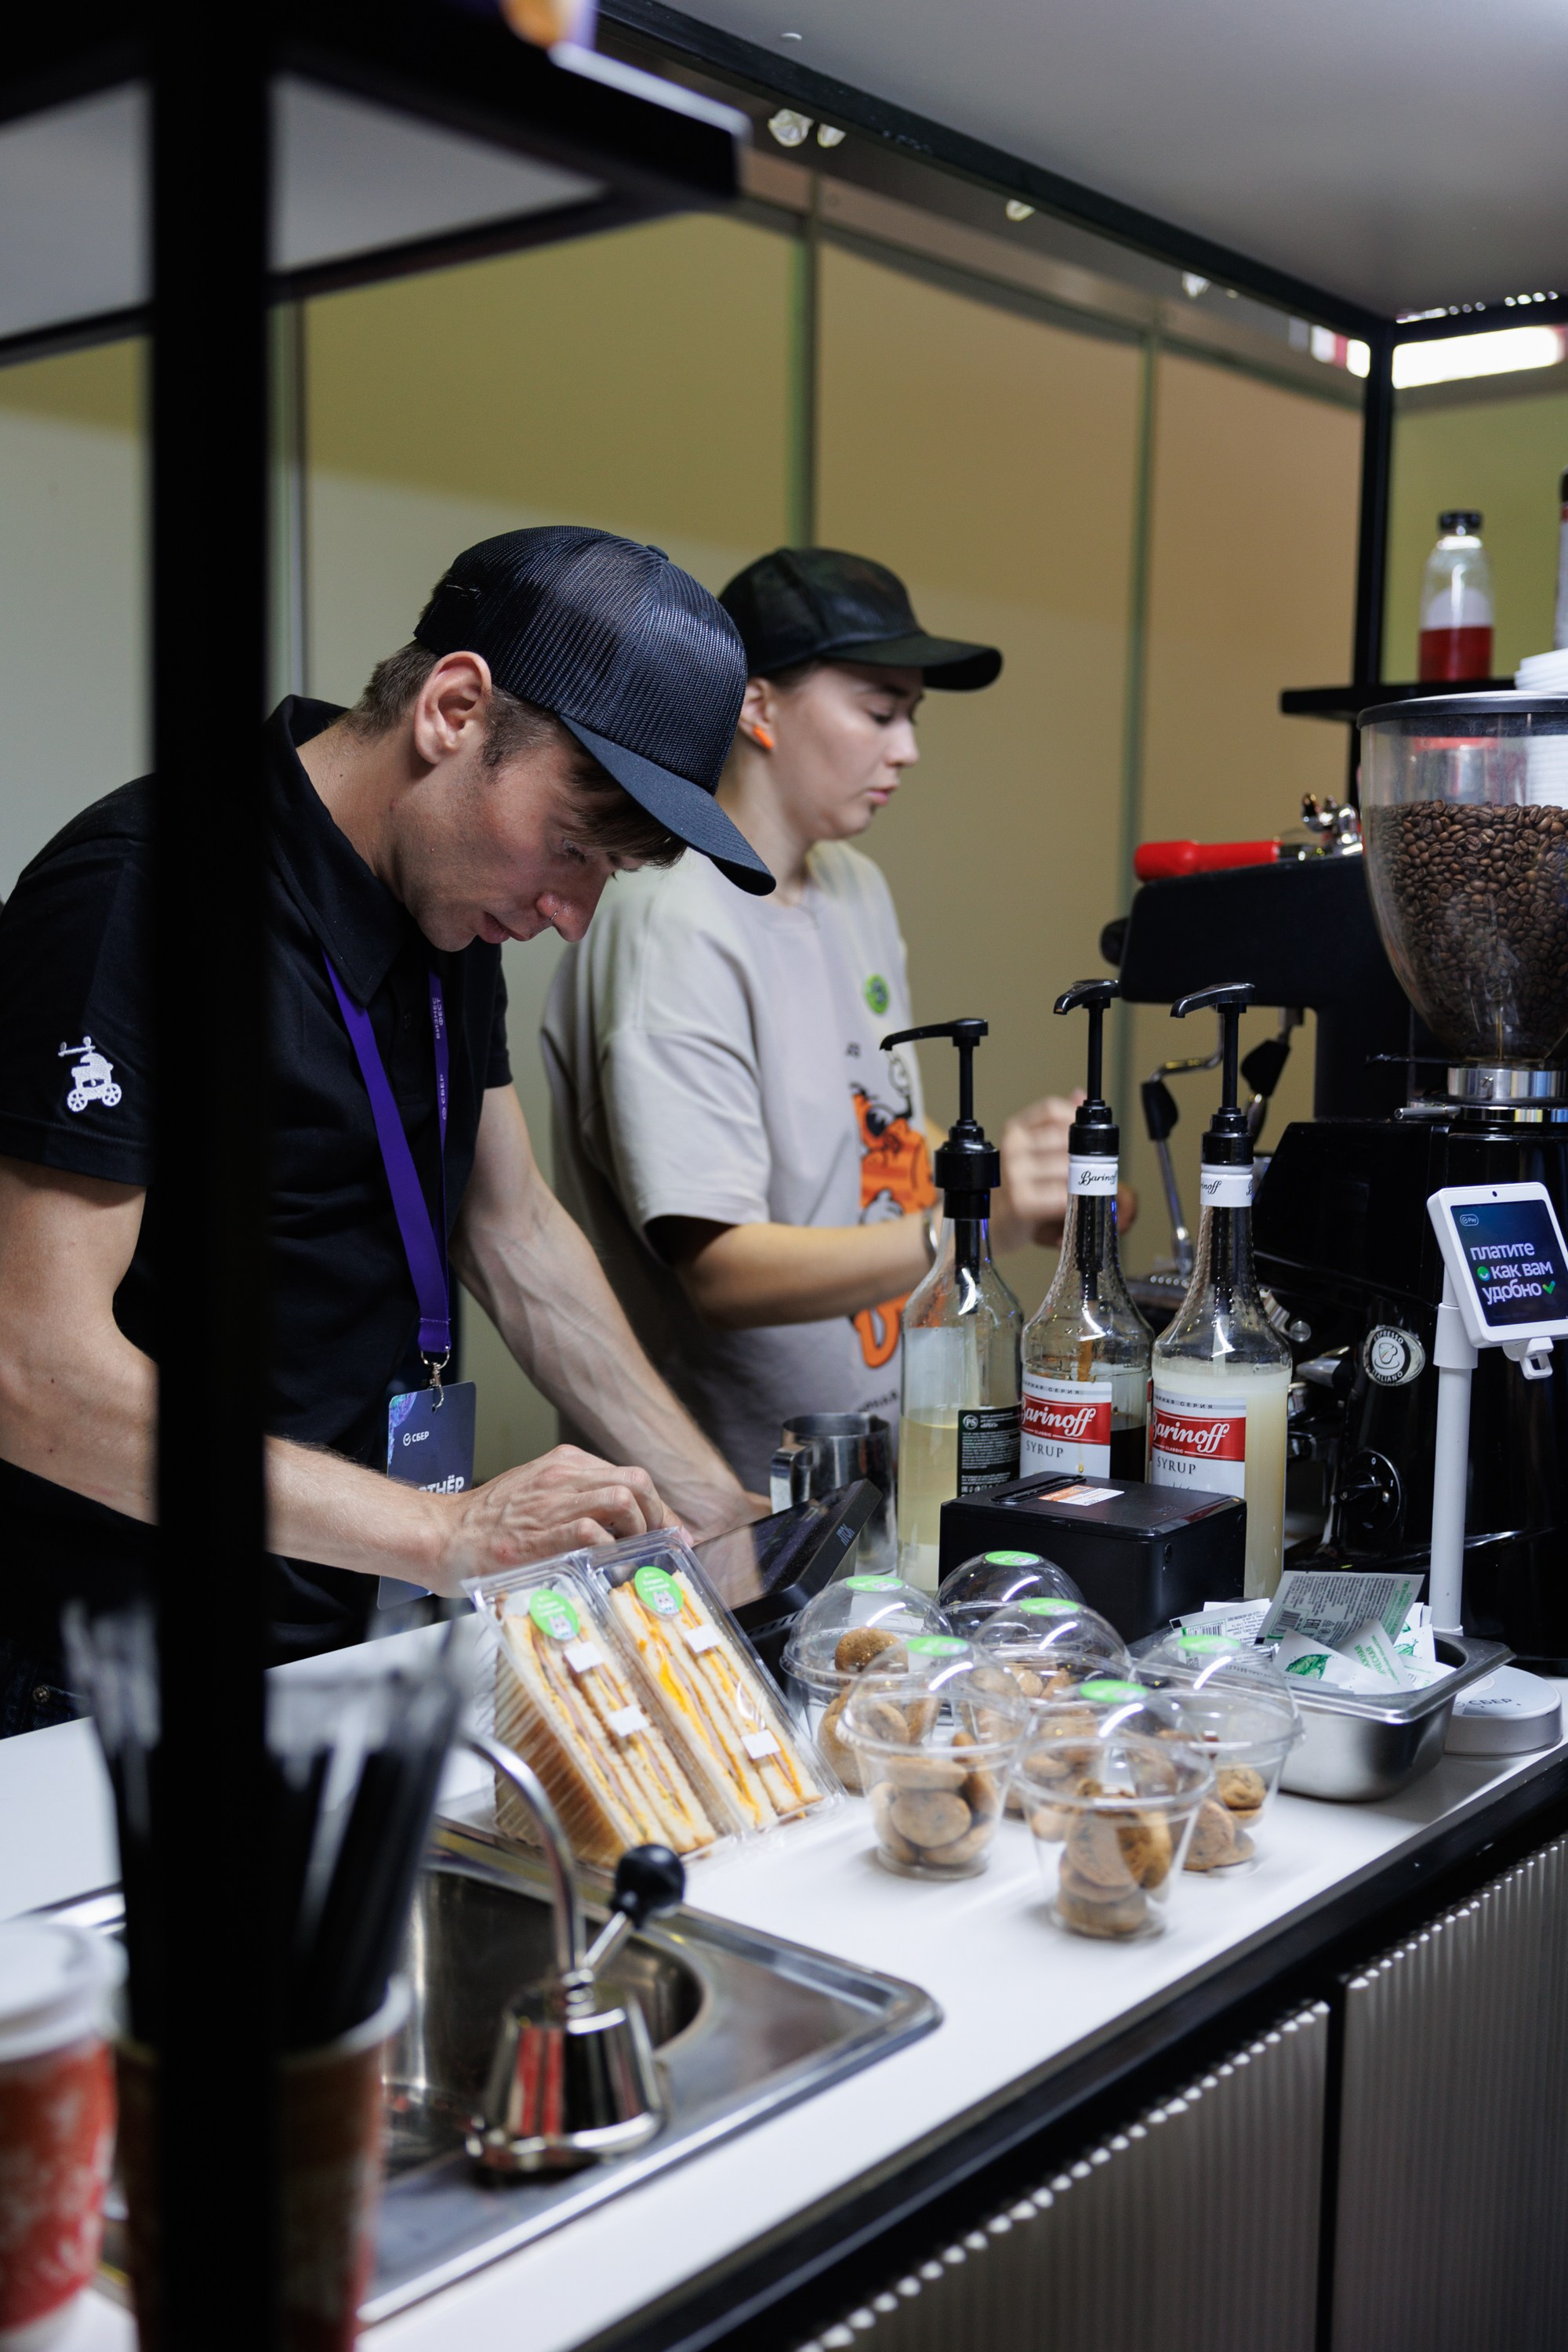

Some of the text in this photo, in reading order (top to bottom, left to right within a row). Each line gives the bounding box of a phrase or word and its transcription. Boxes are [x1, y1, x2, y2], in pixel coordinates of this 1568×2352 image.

[432, 997, 441, 1040] БИЗНЕС
[1470, 1243, 1535, 1260] платите
[1490, 1261, 1554, 1279] как вам
[1482, 1279, 1542, 1305] удобно
[1374, 1330, 1404, 1345] ESPRESSO
[1372, 1370, 1403, 1382] ITALIANO
[412, 1431, 430, 1443] СБЕР
[1026, 1439, 1064, 1458] SYRUP
[1156, 1456, 1196, 1475] SYRUP
[418, 1475, 465, 1495] ТНЁР
